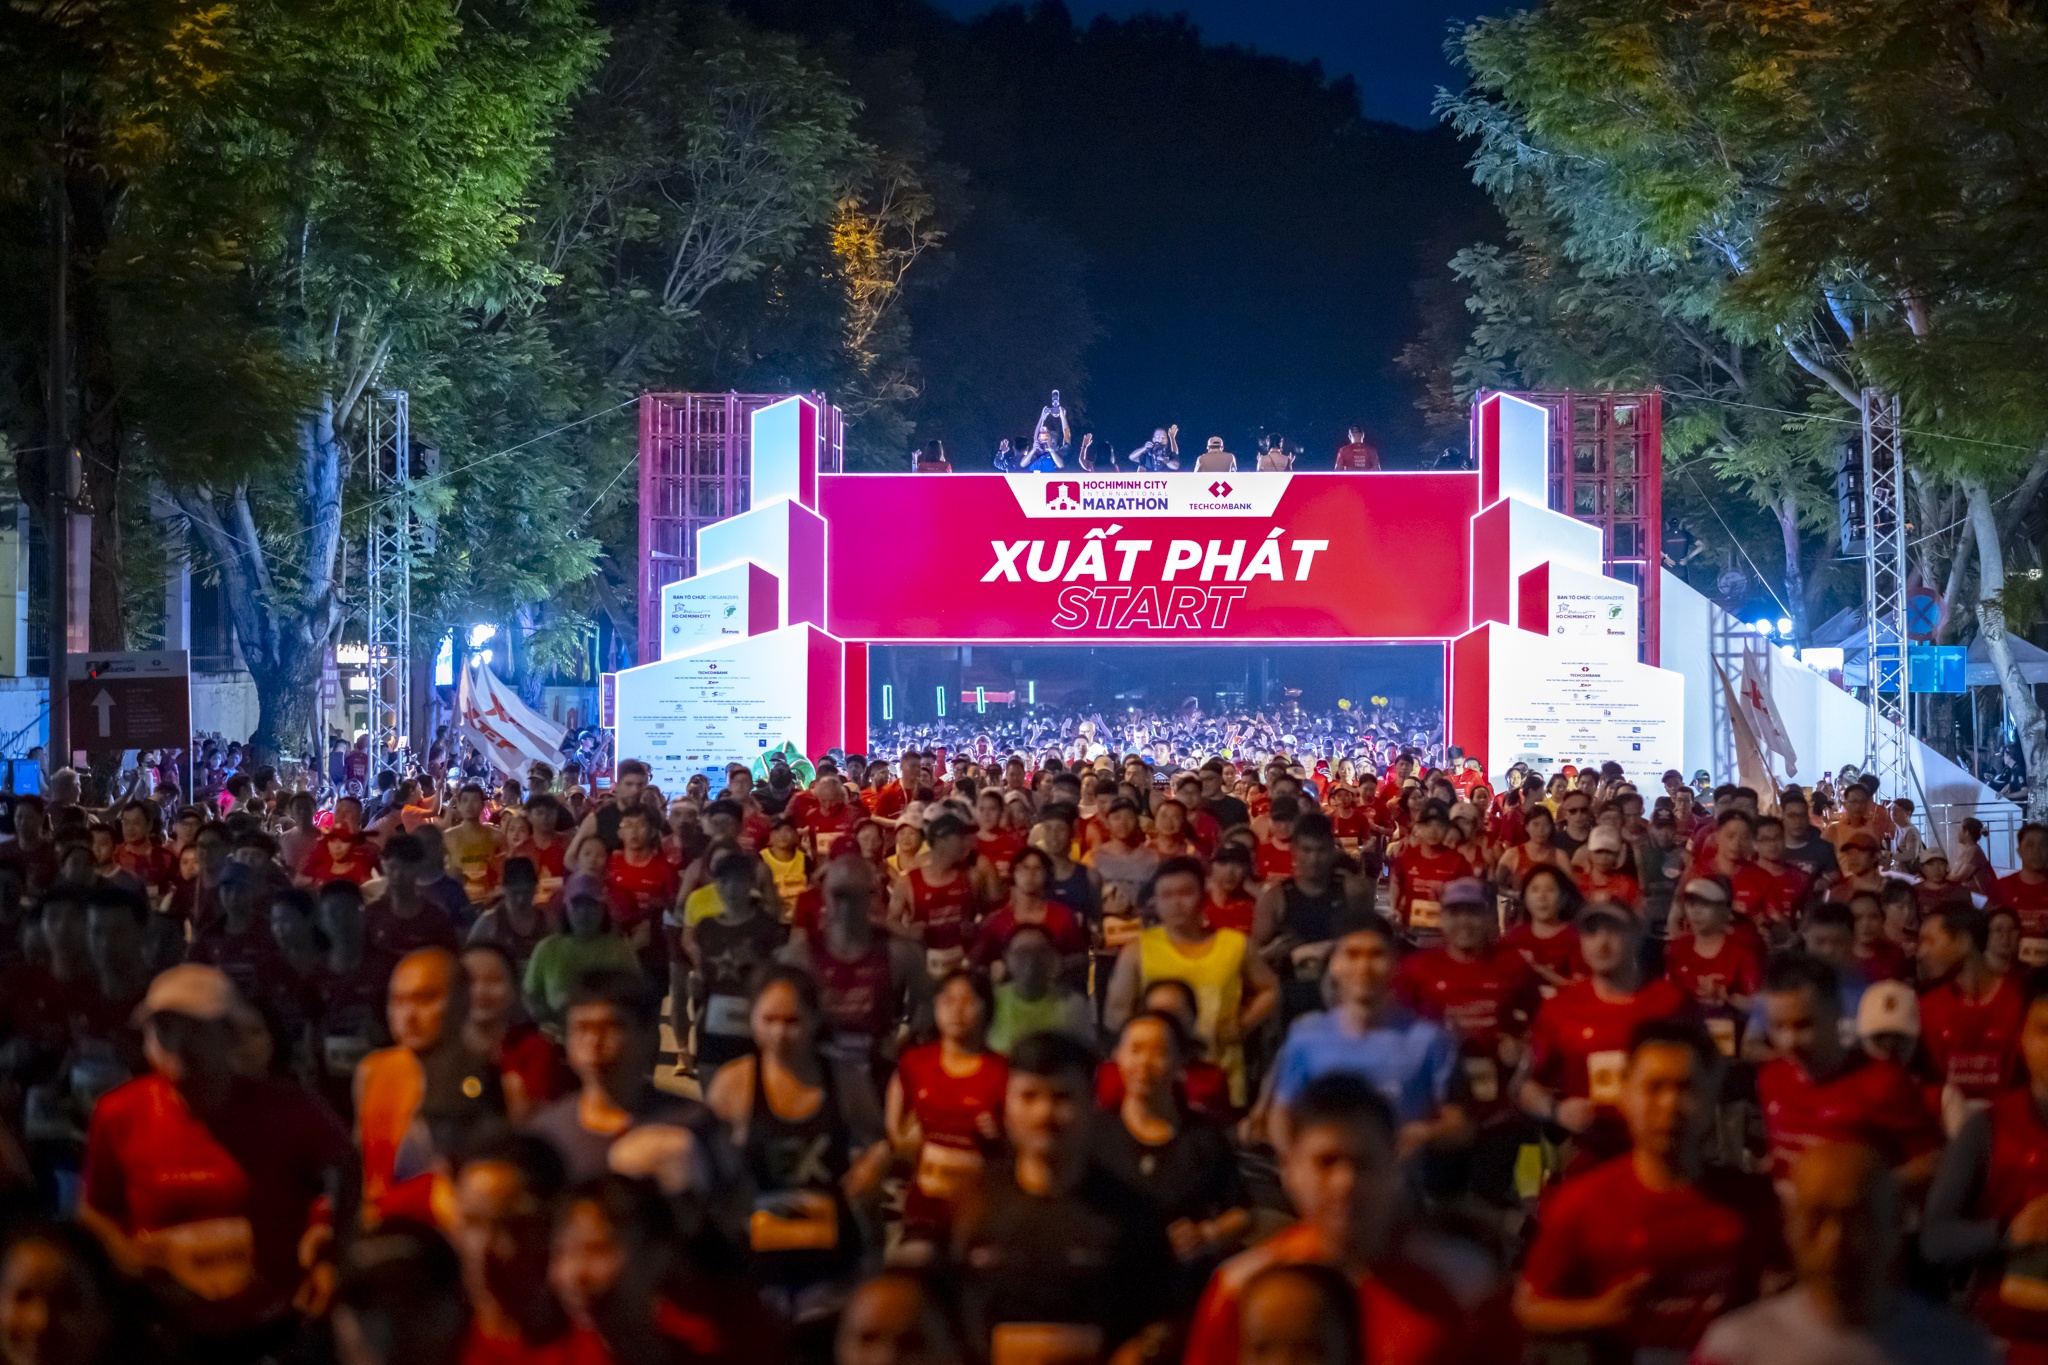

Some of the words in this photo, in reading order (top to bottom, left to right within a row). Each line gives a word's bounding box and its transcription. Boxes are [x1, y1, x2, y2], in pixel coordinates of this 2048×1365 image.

[1083, 481, 1141, 490] HOCHIMINH
[1143, 481, 1168, 489] CITY
[1083, 498, 1168, 510] MARATHON
[979, 523, 1153, 582] XUẤT
[1161, 526, 1329, 581] PHÁT
[1051, 585, 1247, 630] START
